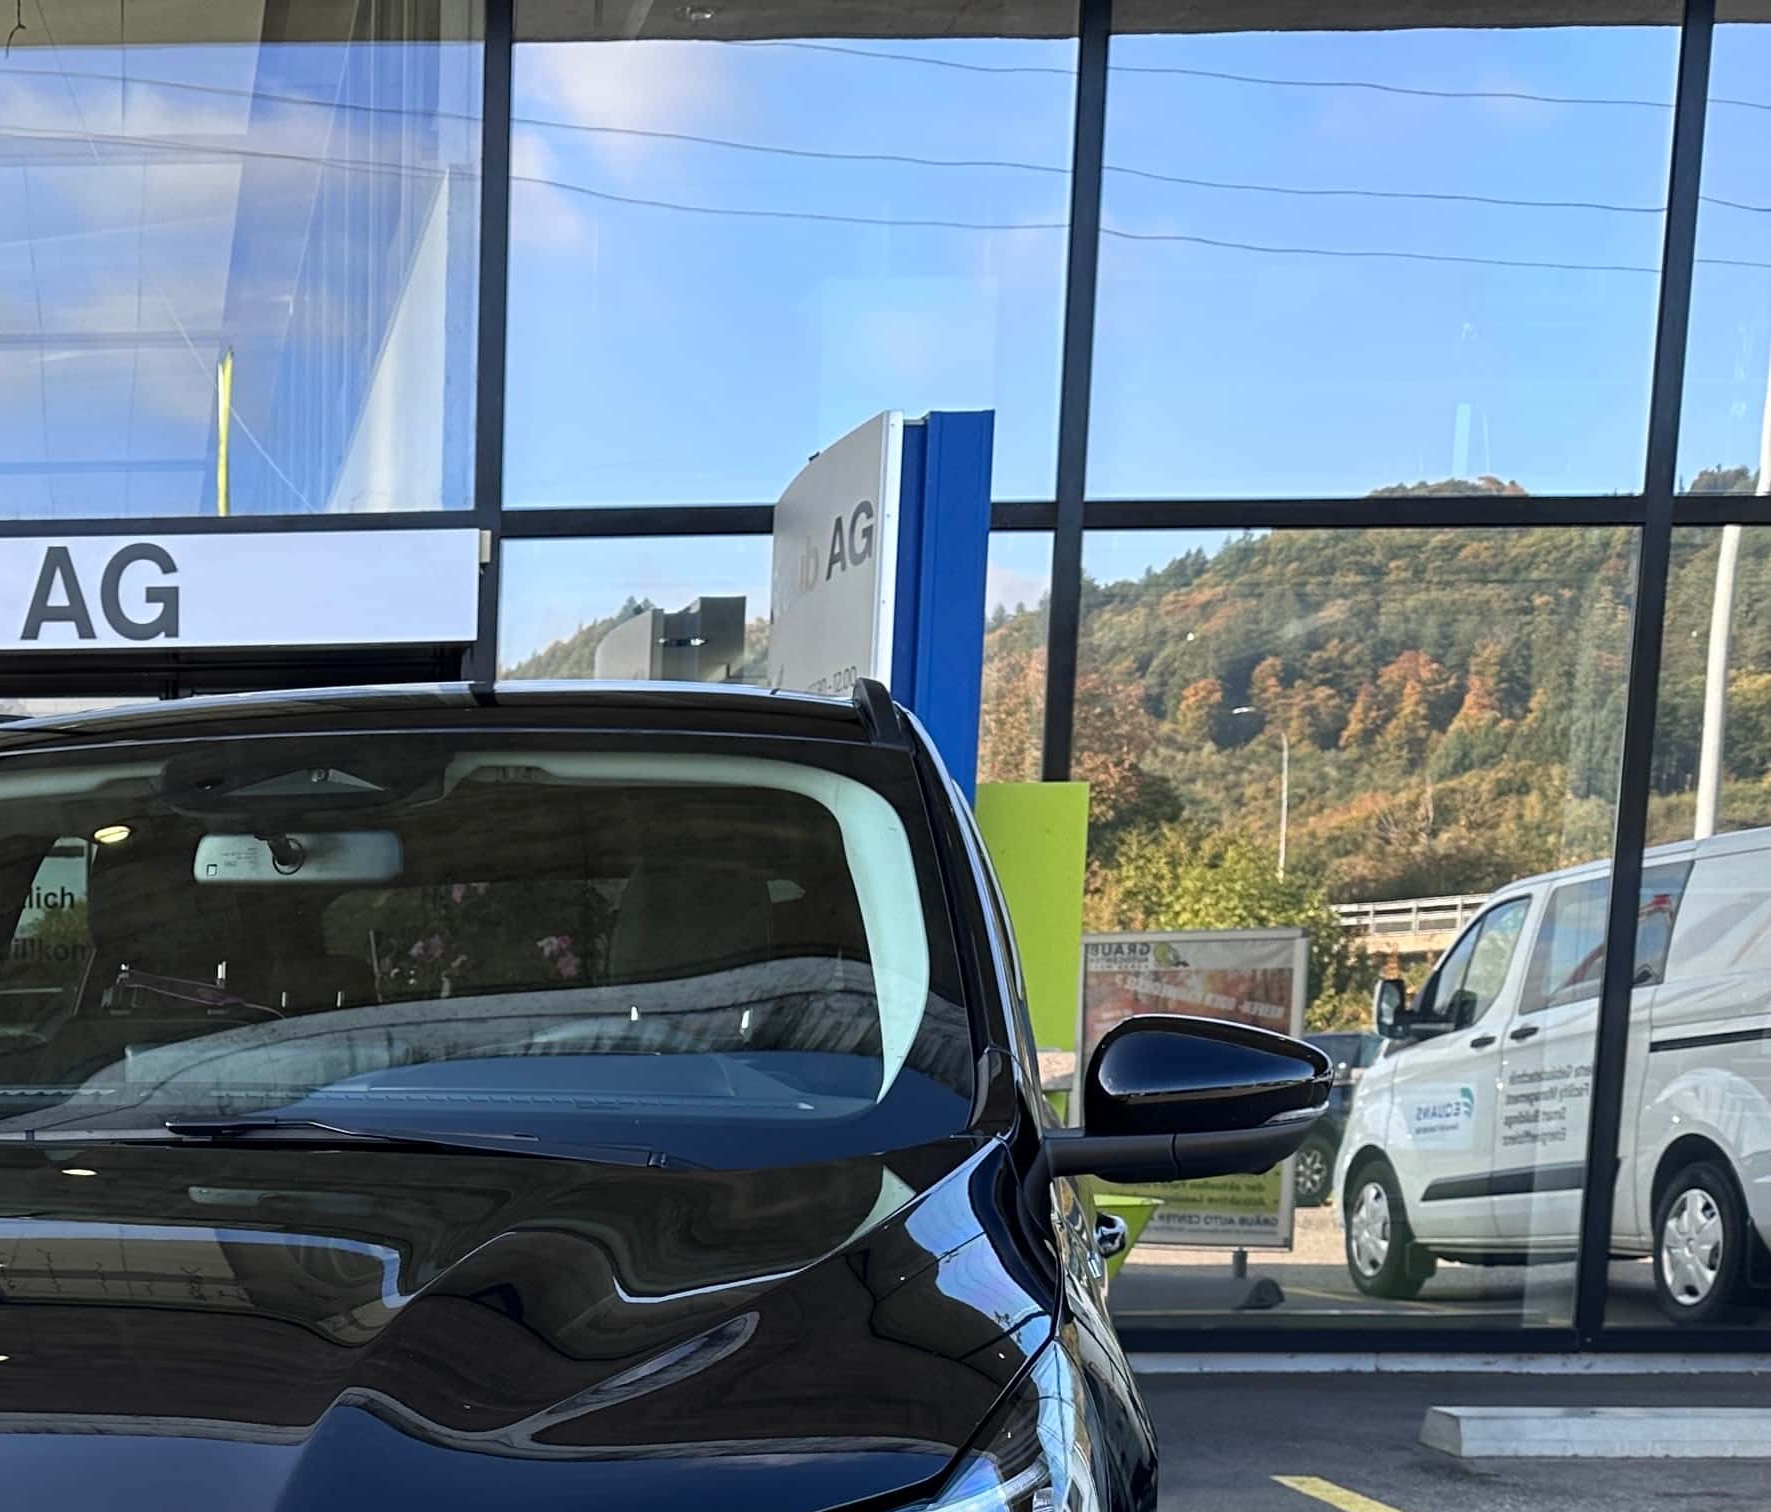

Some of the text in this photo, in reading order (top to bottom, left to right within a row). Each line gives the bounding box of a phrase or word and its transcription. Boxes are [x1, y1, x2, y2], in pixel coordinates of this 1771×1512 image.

[825, 500, 874, 581] AG
[20, 542, 180, 642] AG
[23, 886, 75, 909] lich
